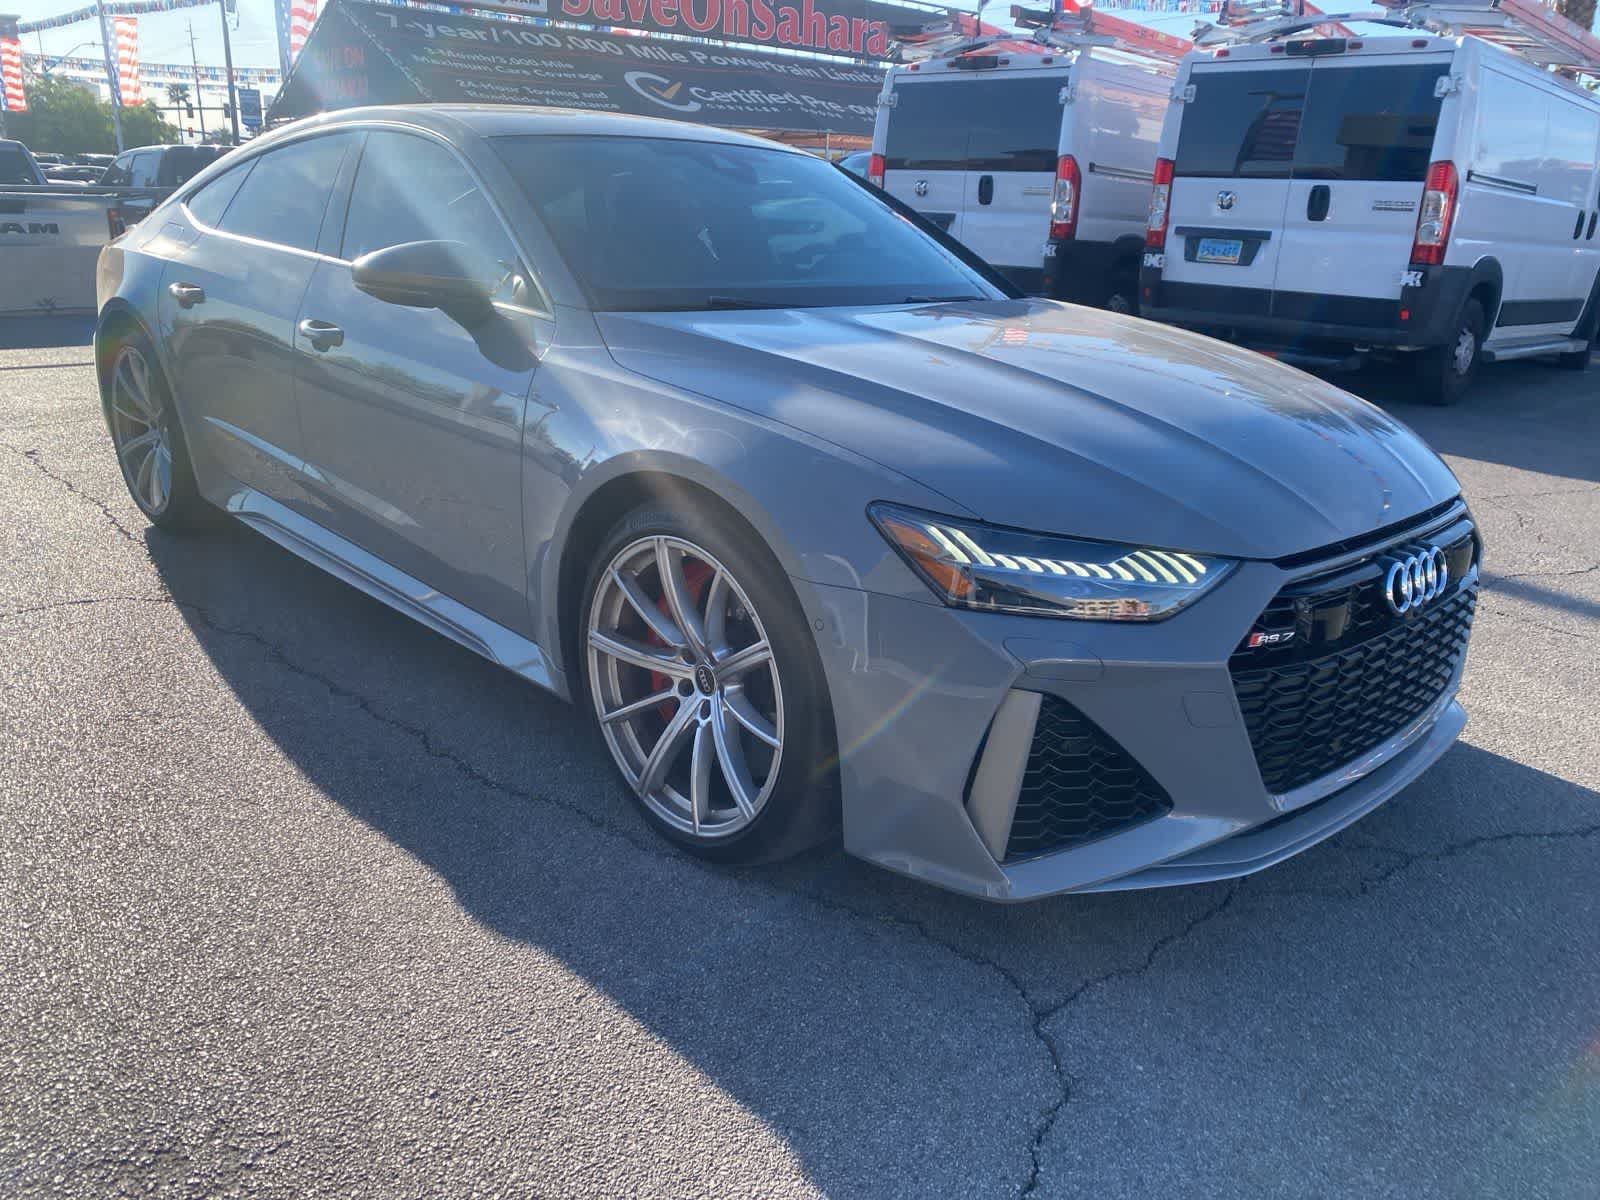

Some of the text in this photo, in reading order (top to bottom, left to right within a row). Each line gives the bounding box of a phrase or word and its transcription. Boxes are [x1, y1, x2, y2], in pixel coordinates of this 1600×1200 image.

[626, 43, 689, 63] Mile
[692, 50, 819, 78] Powertrain
[823, 67, 884, 83] Limite
[688, 86, 802, 105] Certified
[0, 222, 60, 234] AM
